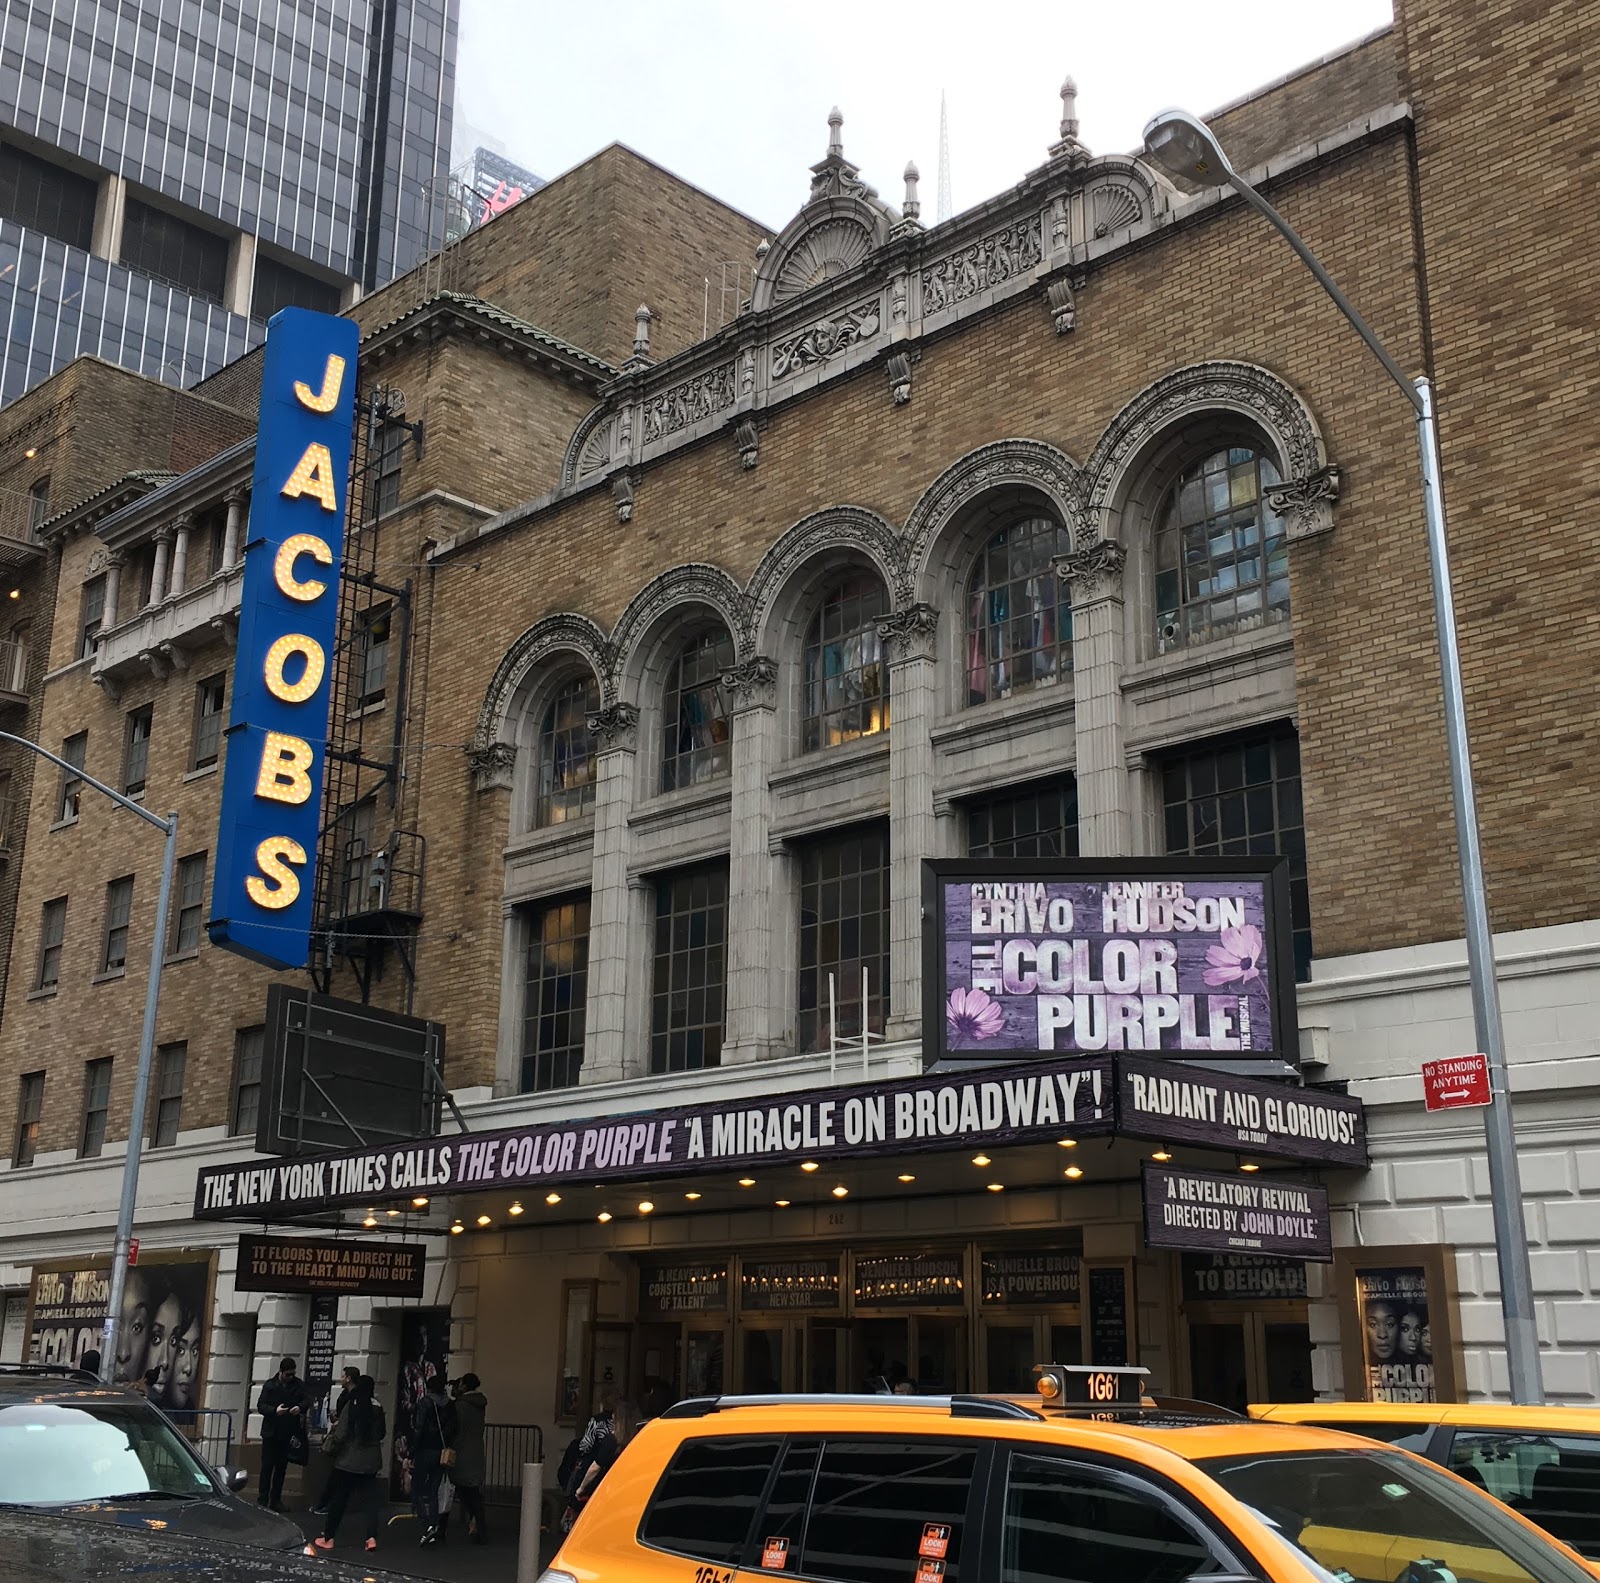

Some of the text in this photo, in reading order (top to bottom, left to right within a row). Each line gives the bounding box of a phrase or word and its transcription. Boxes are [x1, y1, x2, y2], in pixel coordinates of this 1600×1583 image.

[244, 353, 347, 911] JACOBS
[972, 881, 1185, 899] CYNTHIA JENNIFER
[971, 897, 1245, 933] ERIVO HUDSON
[971, 939, 1179, 995] THE COLOR
[1037, 994, 1241, 1050] PURPLE
[1238, 995, 1251, 1051] THE MUSICAL
[1425, 1060, 1482, 1078] NO STANDING
[1432, 1074, 1478, 1090] ANYTIME
[1127, 1072, 1358, 1145] "RADIANT AND GLORIOUS!"
[1238, 1128, 1268, 1144] USA TODAY
[203, 1174, 233, 1209] THE
[236, 1168, 276, 1206] NEW
[279, 1161, 325, 1201] YORK
[330, 1153, 385, 1195] TIMES
[391, 1145, 452, 1191] CALLS
[456, 1140, 501, 1183] THE
[501, 1131, 575, 1177] COLOR
[578, 1119, 677, 1171] PURPLE
[684, 1115, 705, 1160] "A
[711, 1100, 836, 1158] MIRACLE
[843, 1096, 885, 1146] ON
[1164, 1176, 1311, 1214] "A REVELATORY REVIVAL
[1164, 1203, 1318, 1240] DIRECTED BY JOHN DOYLE."
[269, 1247, 313, 1262] FLOORS
[316, 1248, 341, 1263] YOU.
[342, 1251, 350, 1263] A
[353, 1252, 392, 1266] DIRECT
[394, 1254, 413, 1267] HIT
[990, 1256, 1081, 1274] DANIELLE BROO
[252, 1260, 268, 1274] TO
[270, 1262, 292, 1276] THE
[295, 1263, 334, 1278] HEART,
[336, 1265, 366, 1278] MIND
[368, 1267, 388, 1280] AND
[861, 1260, 958, 1278] JENNIFER HUDSON
[648, 1281, 719, 1296] CONSTELLATION
[986, 1277, 996, 1292] IS
[998, 1276, 1006, 1292] A
[1008, 1274, 1081, 1292] POWERHOU
[1194, 1270, 1219, 1291] TO
[36, 1280, 109, 1304] ERIVO HUDSON
[770, 1292, 788, 1307] NEW
[660, 1296, 670, 1310] OF
[1088, 1373, 1119, 1400] 1G61
[924, 1539, 944, 1548] LOOK!
[920, 1572, 940, 1582] LOOK!
